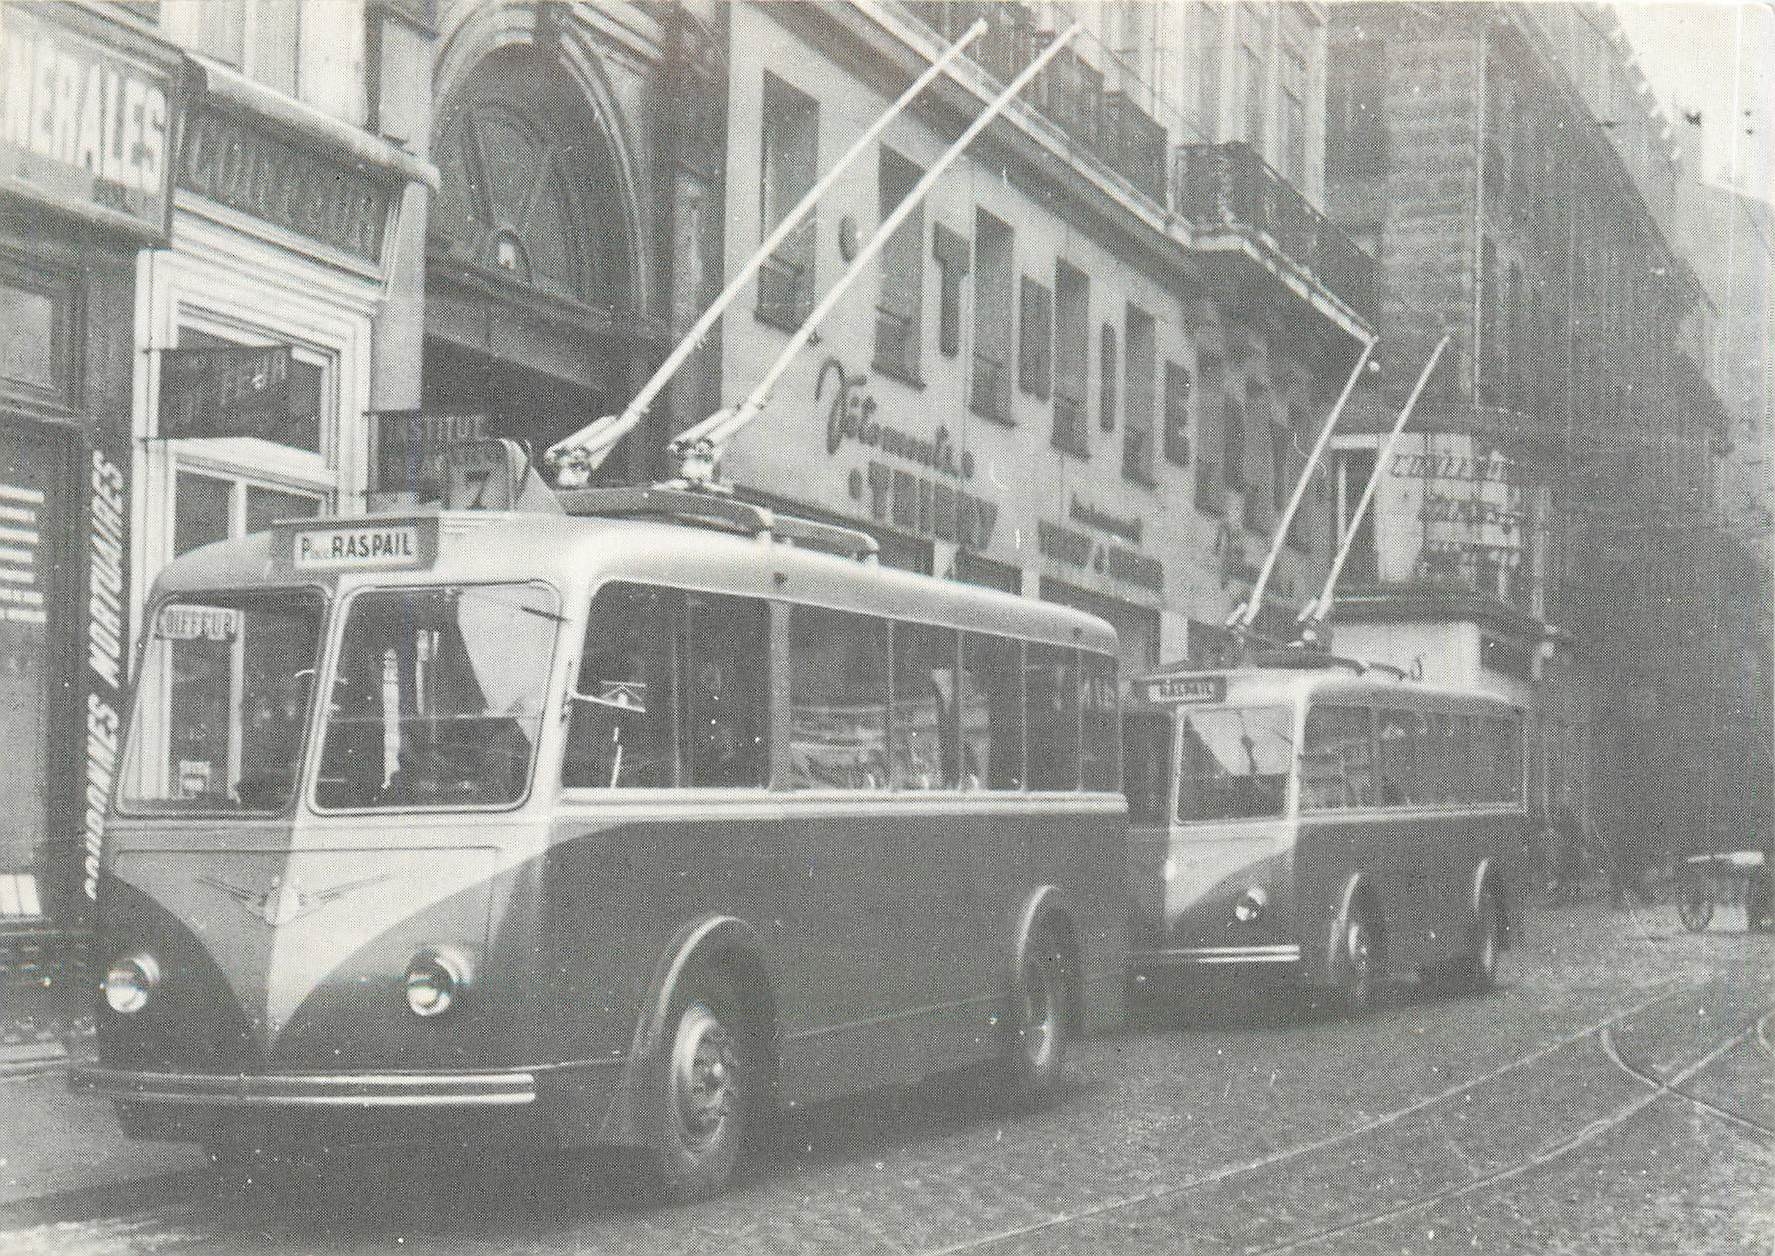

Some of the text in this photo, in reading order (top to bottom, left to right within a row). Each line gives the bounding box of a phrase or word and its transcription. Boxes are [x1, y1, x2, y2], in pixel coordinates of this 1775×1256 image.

[465, 469, 491, 511] 7
[331, 532, 412, 559] RASPAIL
[89, 451, 124, 688] MORTUAIRES
